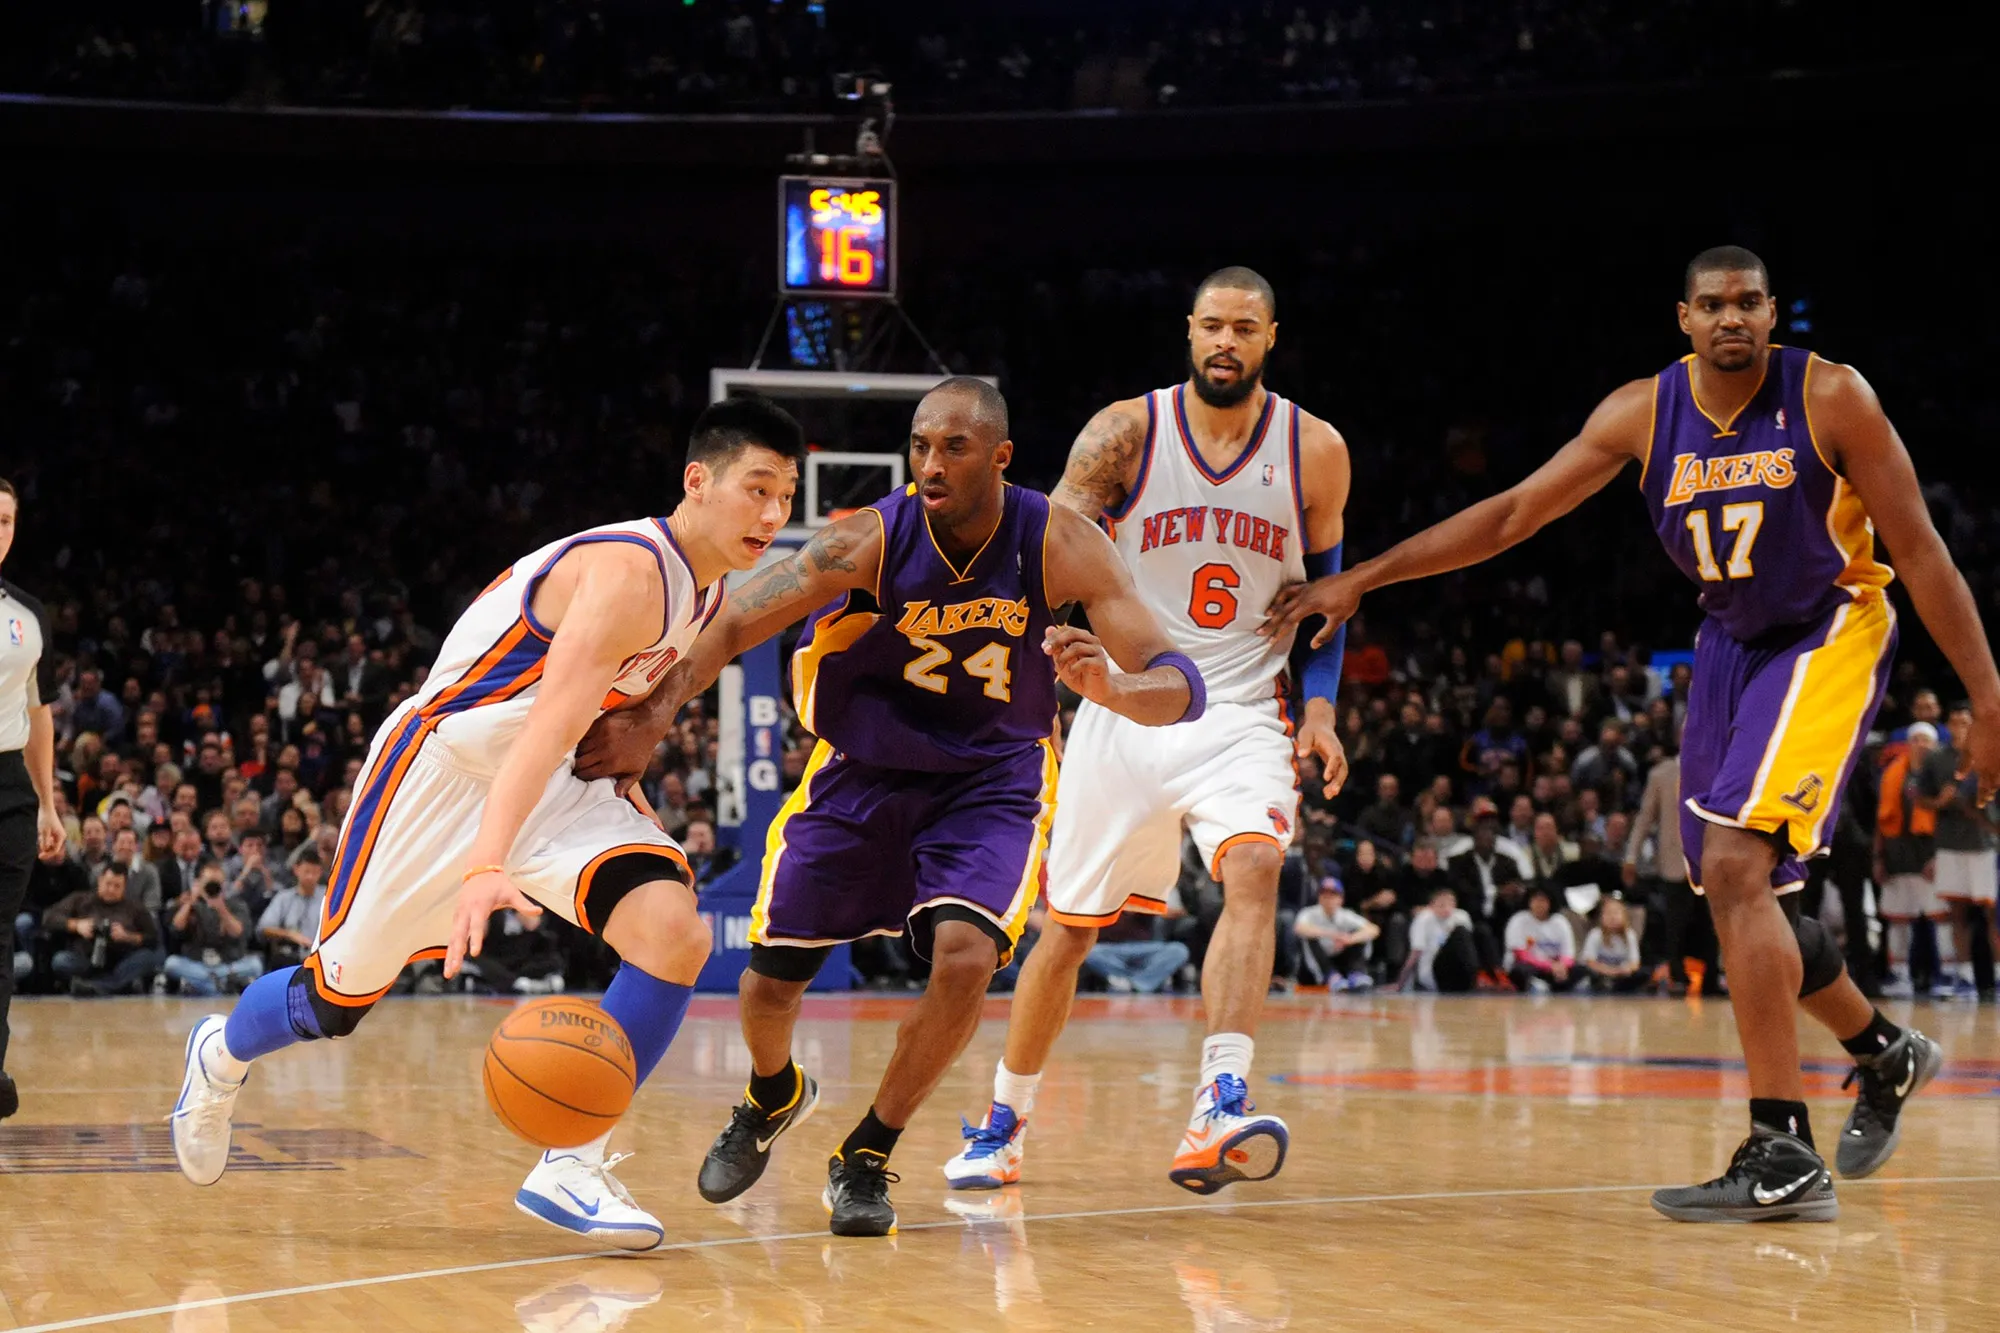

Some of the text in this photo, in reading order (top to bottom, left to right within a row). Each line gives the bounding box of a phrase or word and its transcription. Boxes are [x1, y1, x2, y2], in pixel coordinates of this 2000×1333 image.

[809, 189, 881, 225] 5:45
[820, 224, 874, 285] 16
[1664, 447, 1797, 508] LAKERS
[1140, 506, 1289, 562] NEW YORK
[1685, 501, 1764, 581] 17
[895, 595, 1030, 637] LAKERS
[1187, 563, 1241, 630] 6
[903, 635, 1011, 703] 24
